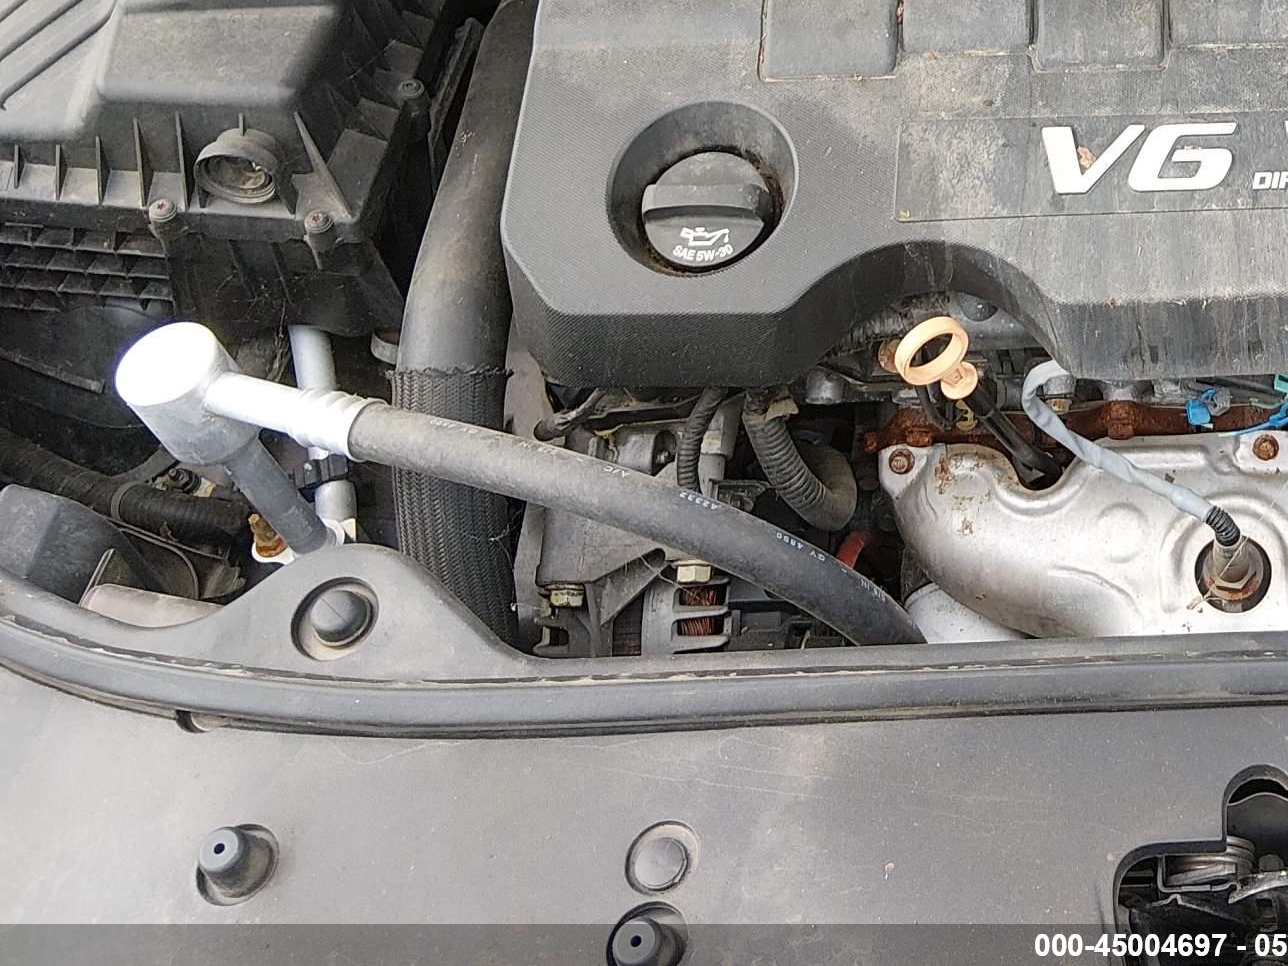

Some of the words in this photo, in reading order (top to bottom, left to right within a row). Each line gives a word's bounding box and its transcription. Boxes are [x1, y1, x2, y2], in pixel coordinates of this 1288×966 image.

[1041, 122, 1238, 194] V6
[672, 245, 695, 261] SAE
[696, 244, 733, 261] 5W-30
